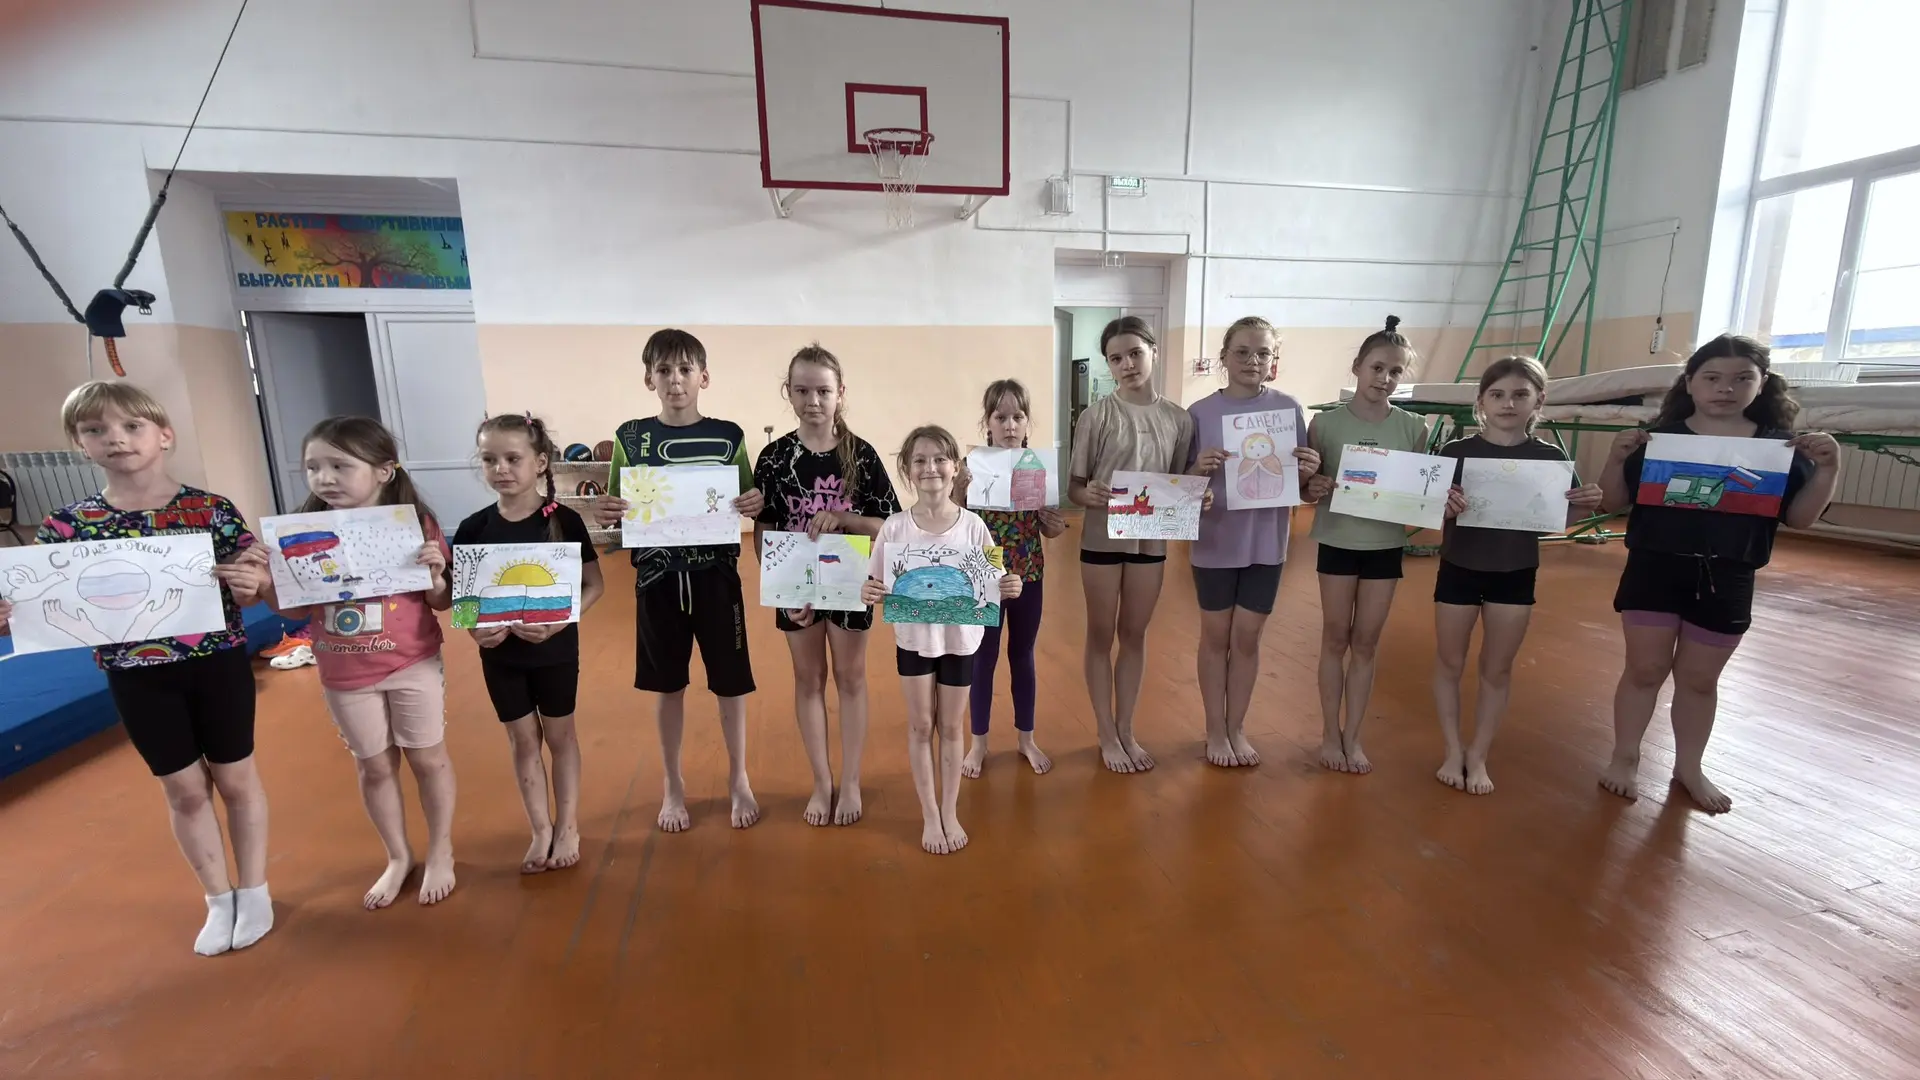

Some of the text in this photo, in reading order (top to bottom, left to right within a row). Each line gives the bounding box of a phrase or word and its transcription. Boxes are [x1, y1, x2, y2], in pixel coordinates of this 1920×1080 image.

[1113, 178, 1138, 187] ВЫХОД
[238, 272, 340, 288] ВЫРАСТАЕМ
[640, 431, 651, 458] FILA
[48, 551, 70, 570] С
